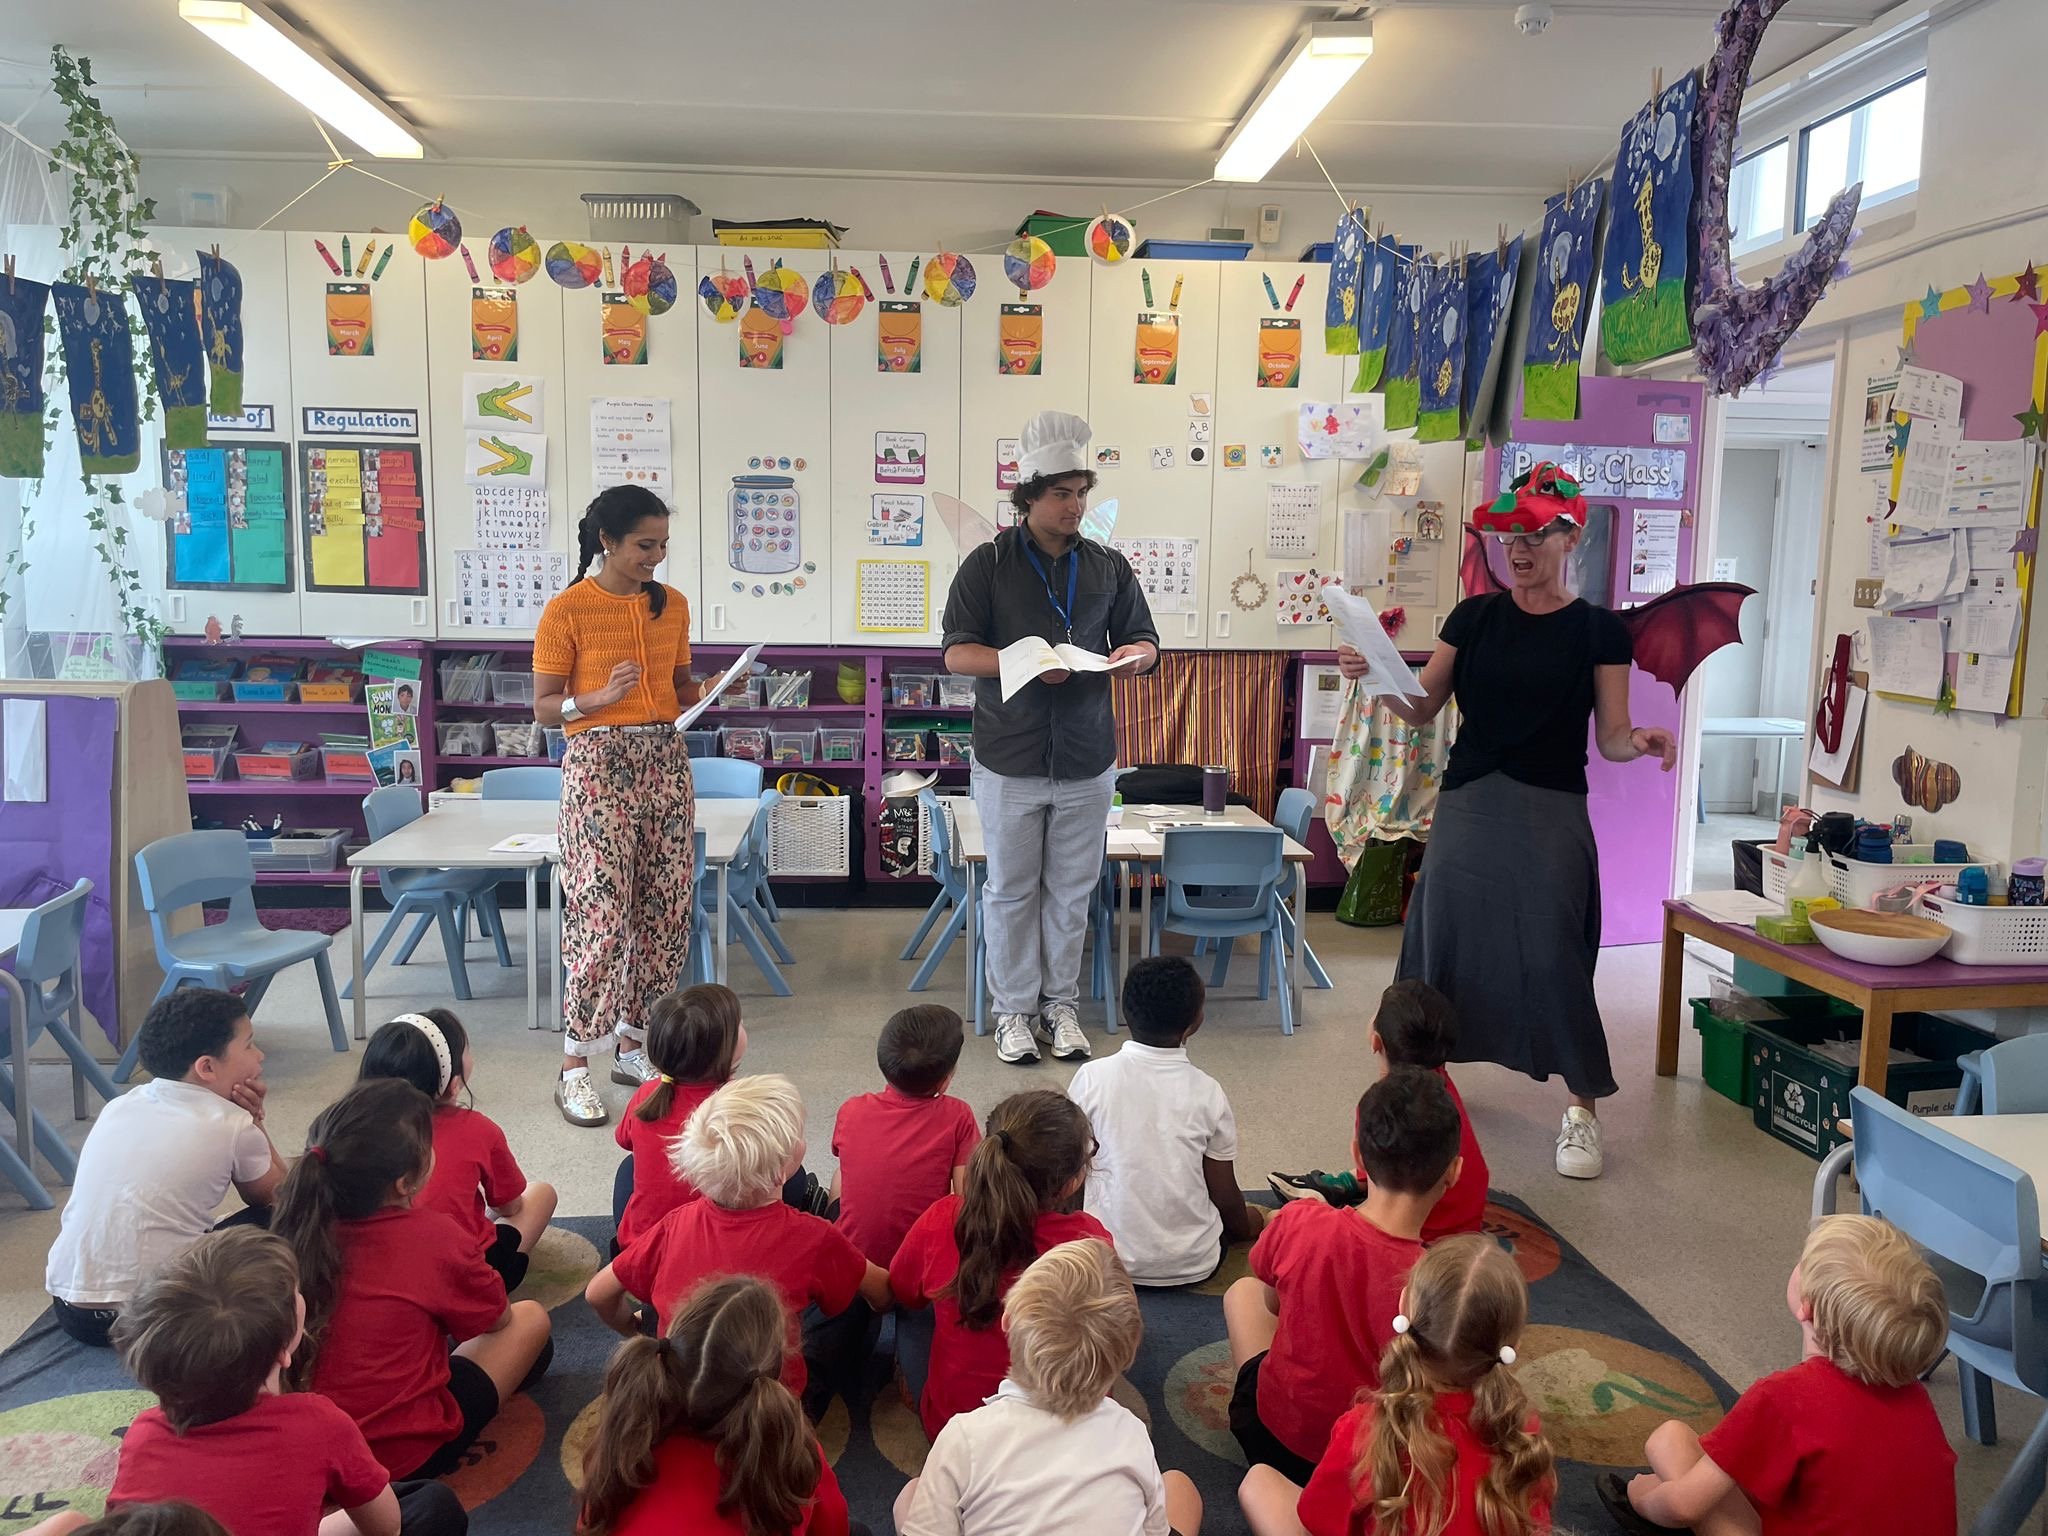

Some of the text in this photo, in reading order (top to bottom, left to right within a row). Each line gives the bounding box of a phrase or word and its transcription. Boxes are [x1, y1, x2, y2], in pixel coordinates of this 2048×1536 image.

[340, 329, 359, 337] March
[487, 334, 503, 342] April
[617, 338, 632, 347] May
[893, 347, 906, 355] July
[1141, 359, 1171, 367] September
[247, 408, 265, 428] of
[314, 411, 412, 432] Regulation
[1190, 422, 1209, 431] A B
[1195, 431, 1203, 440] C
[1154, 448, 1173, 458] A B
[1160, 457, 1168, 467] C
[1604, 454, 1671, 486] Class
[329, 475, 358, 484] excited
[326, 515, 344, 524] silly
[1131, 540, 1142, 549] ch
[1149, 540, 1159, 550] sh
[1165, 540, 1175, 550] th
[1182, 543, 1192, 553] ng
[460, 553, 471, 561] ck
[497, 553, 508, 562] ch
[514, 553, 525, 562] sh
[532, 554, 542, 563] th
[550, 556, 562, 567] ng
[461, 571, 472, 580] nk
[533, 591, 542, 599] oi
[371, 690, 393, 705] BUN
[374, 704, 391, 714] MON
[1912, 1101, 1955, 1115] Purple cla
[1774, 1104, 1817, 1132] WE RECYCLE
